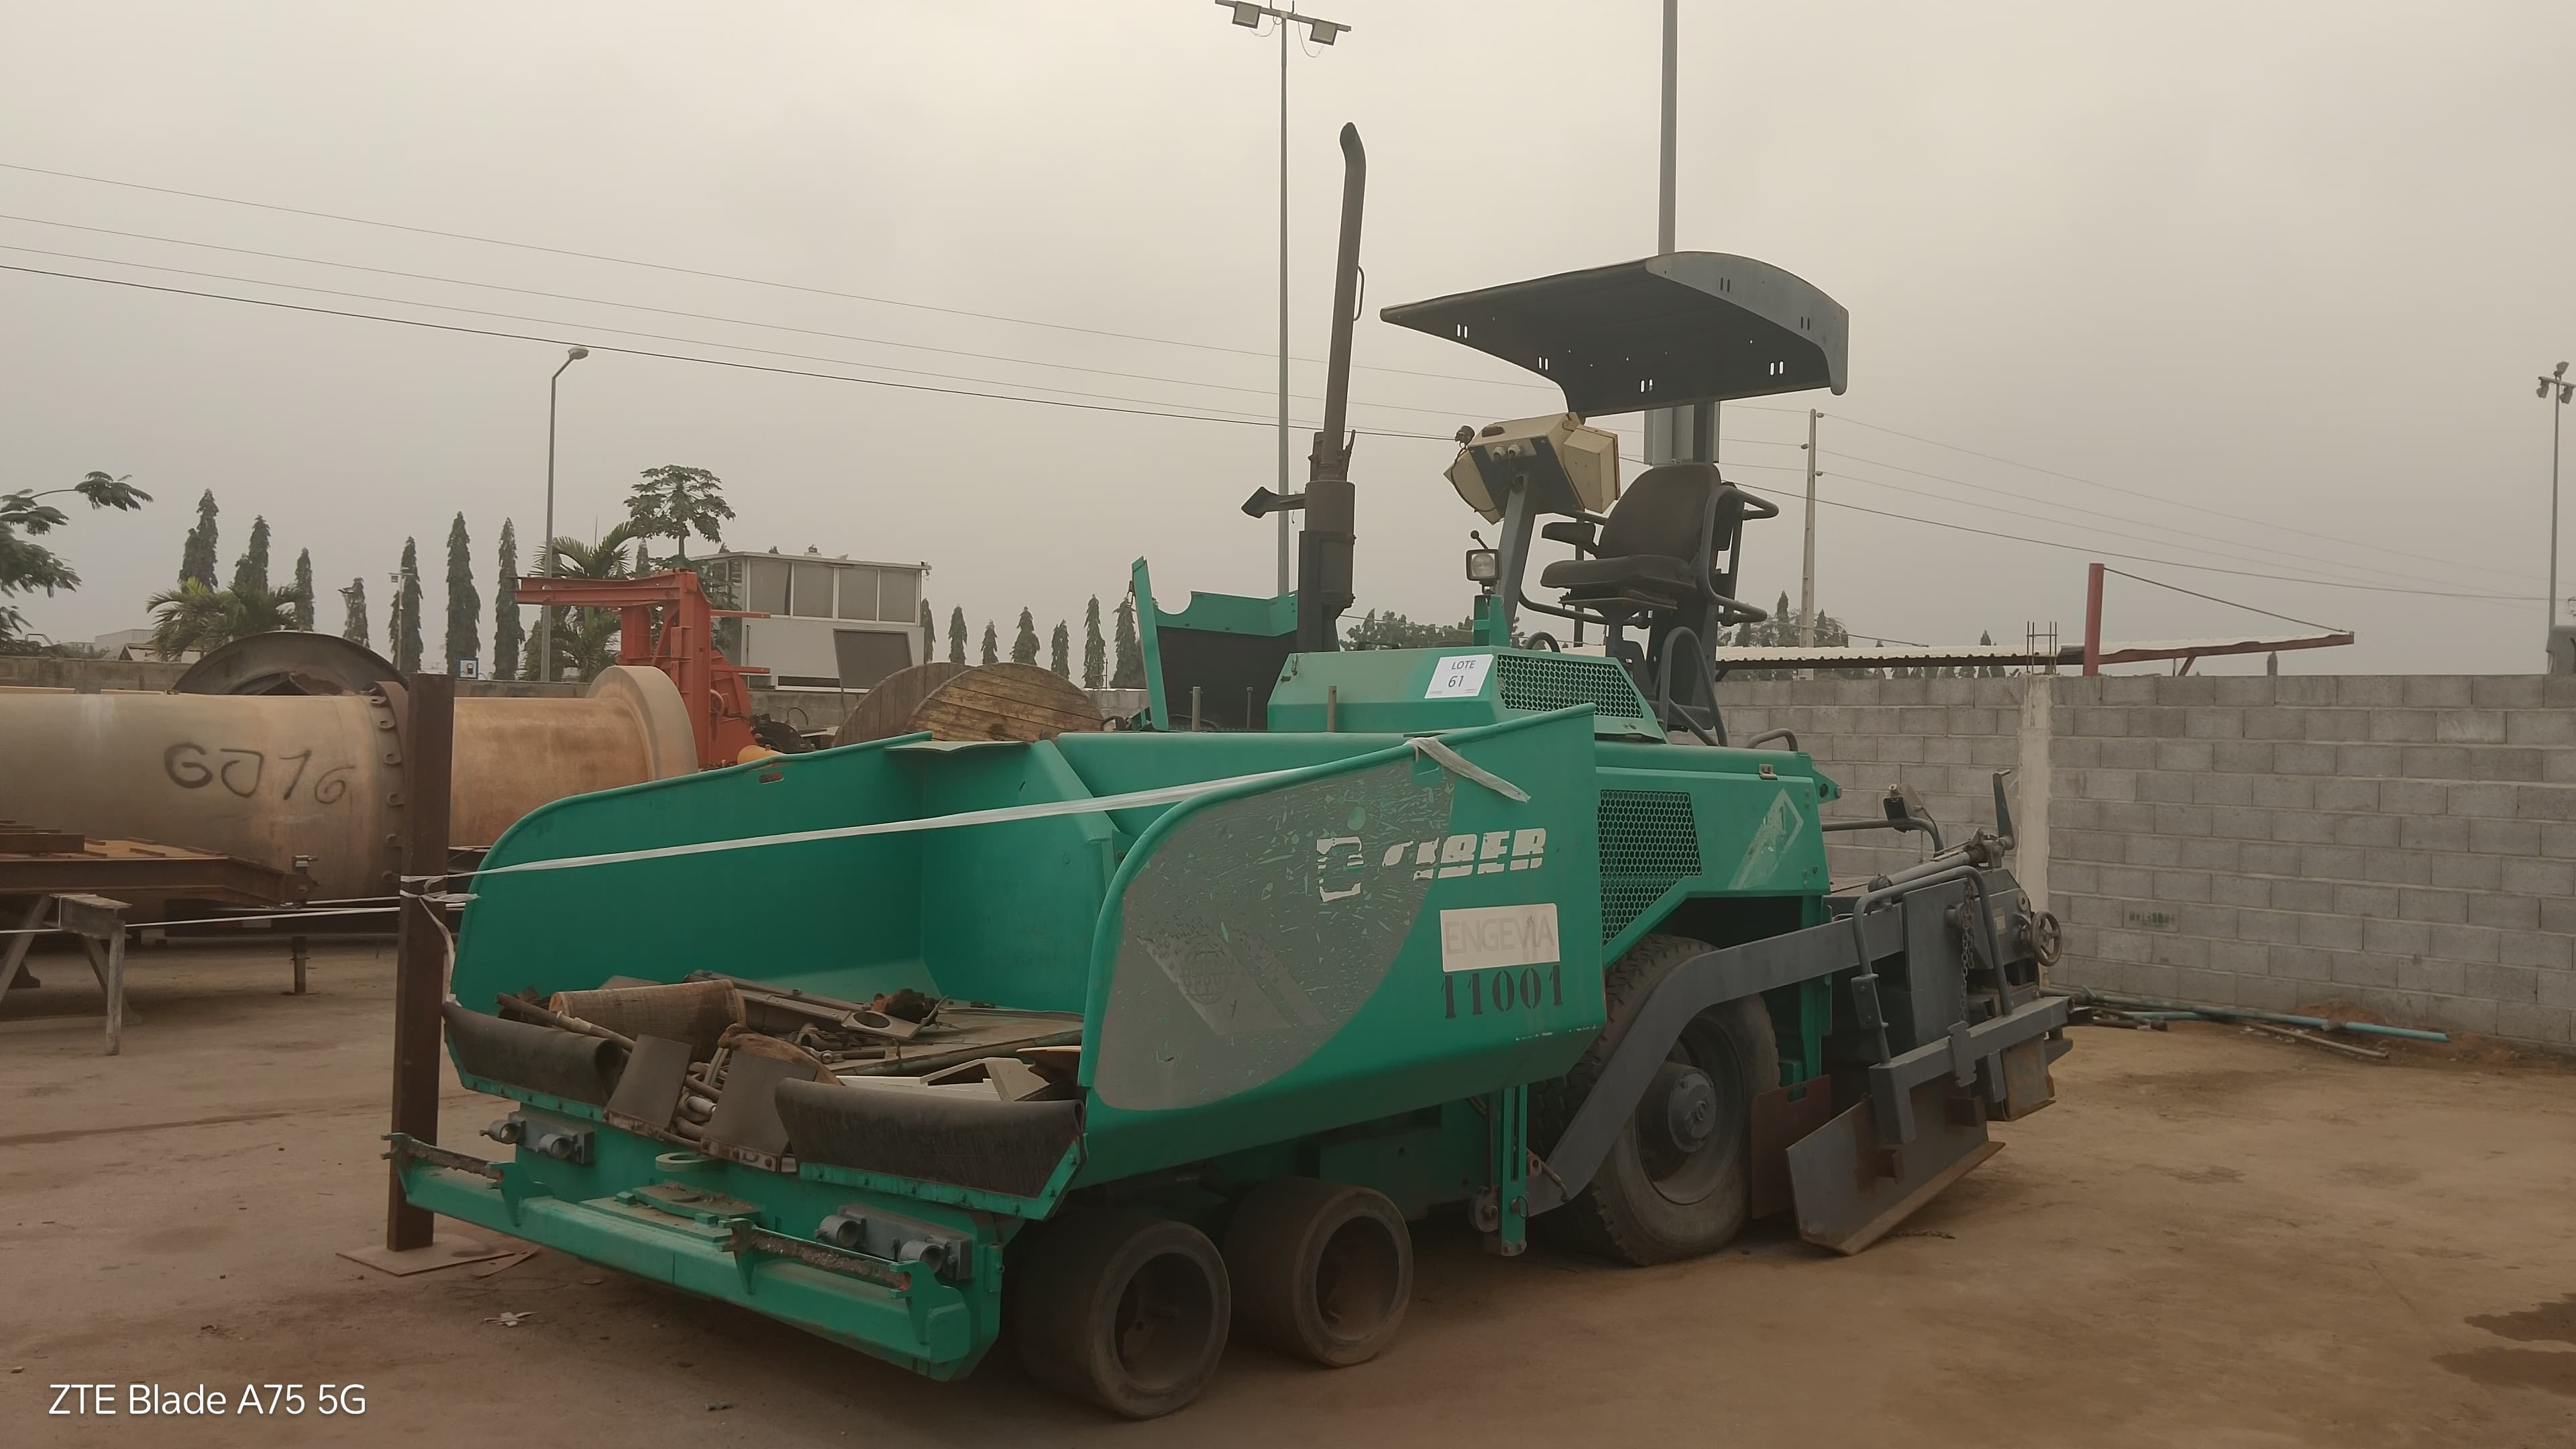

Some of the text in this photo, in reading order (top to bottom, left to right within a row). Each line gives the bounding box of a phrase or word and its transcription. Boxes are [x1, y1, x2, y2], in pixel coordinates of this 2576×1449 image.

[1451, 659, 1477, 670] LOTE
[1448, 675, 1464, 688] 61
[1444, 914, 1556, 955] ENGEVIA
[1441, 965, 1562, 1019] 11001
